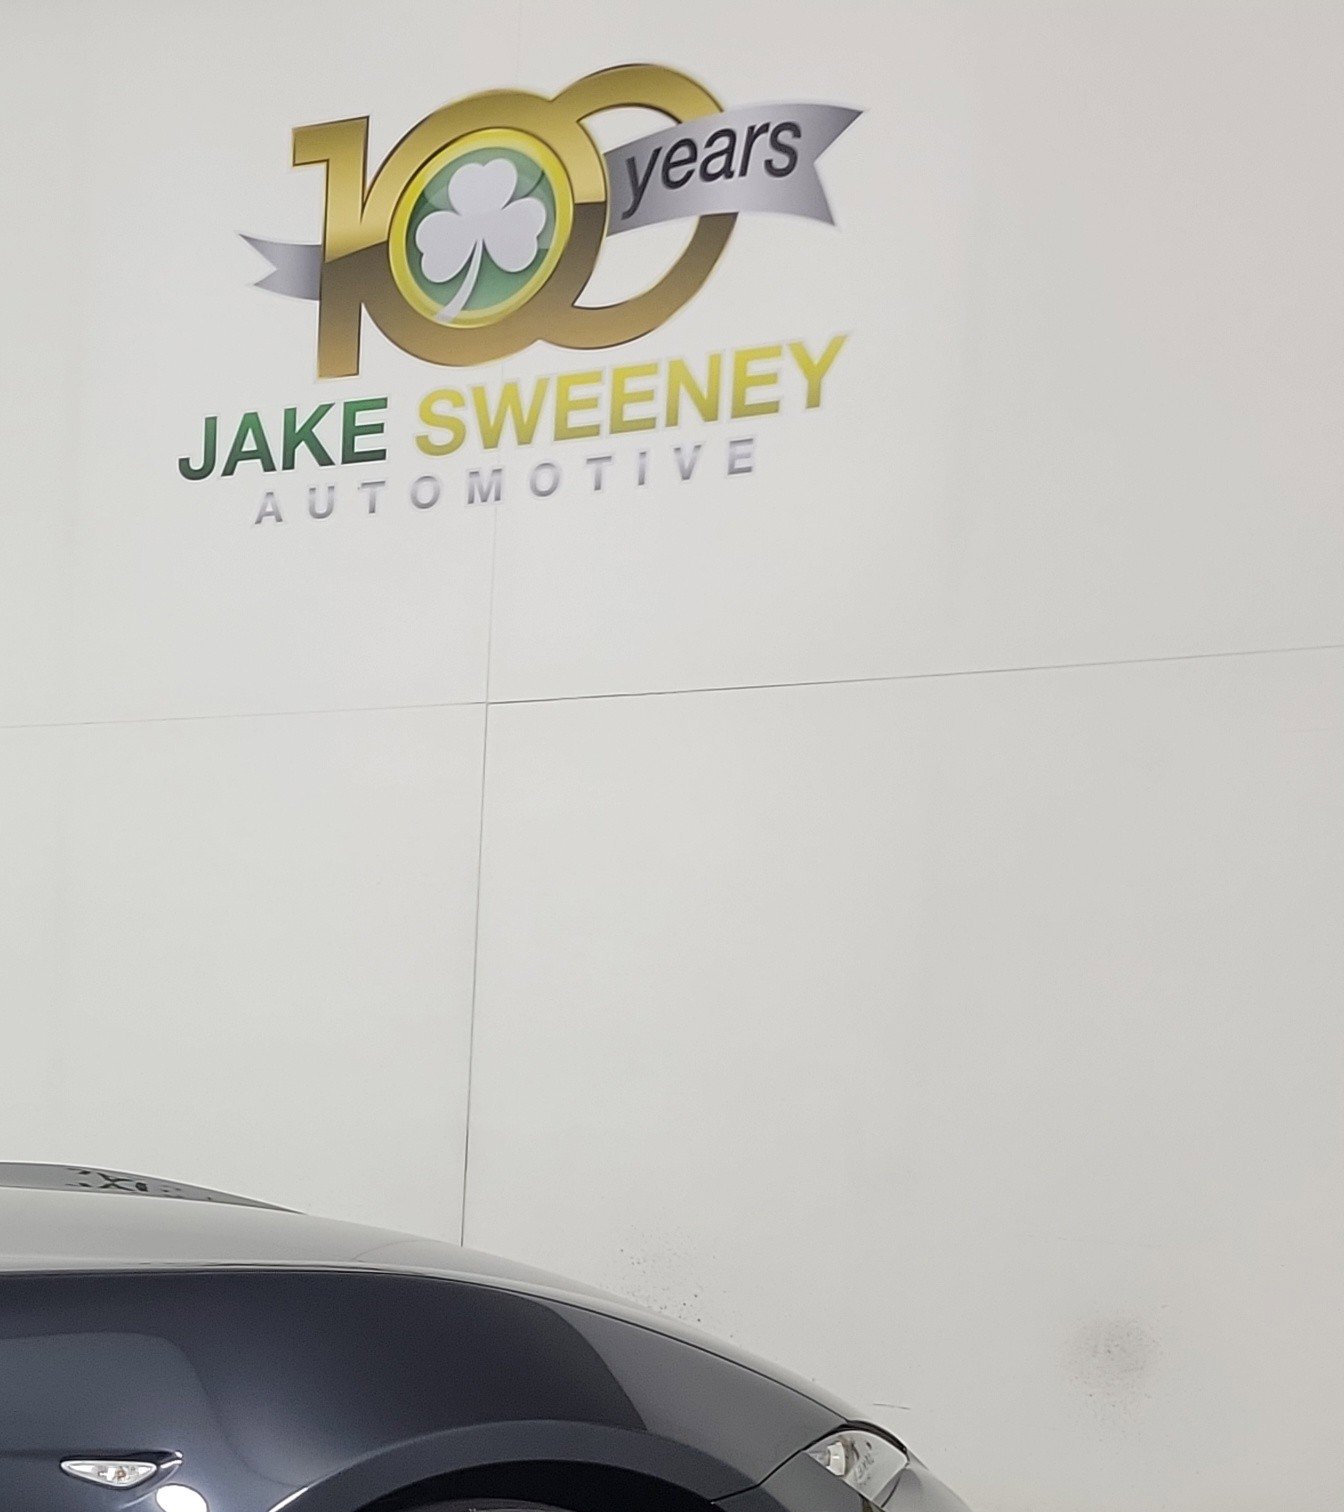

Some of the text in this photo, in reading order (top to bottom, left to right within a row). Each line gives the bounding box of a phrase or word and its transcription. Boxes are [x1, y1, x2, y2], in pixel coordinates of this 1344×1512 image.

[620, 118, 802, 220] years
[178, 335, 848, 483] JAKE SWEENEY
[254, 437, 755, 526] AUTOMOTIVE
